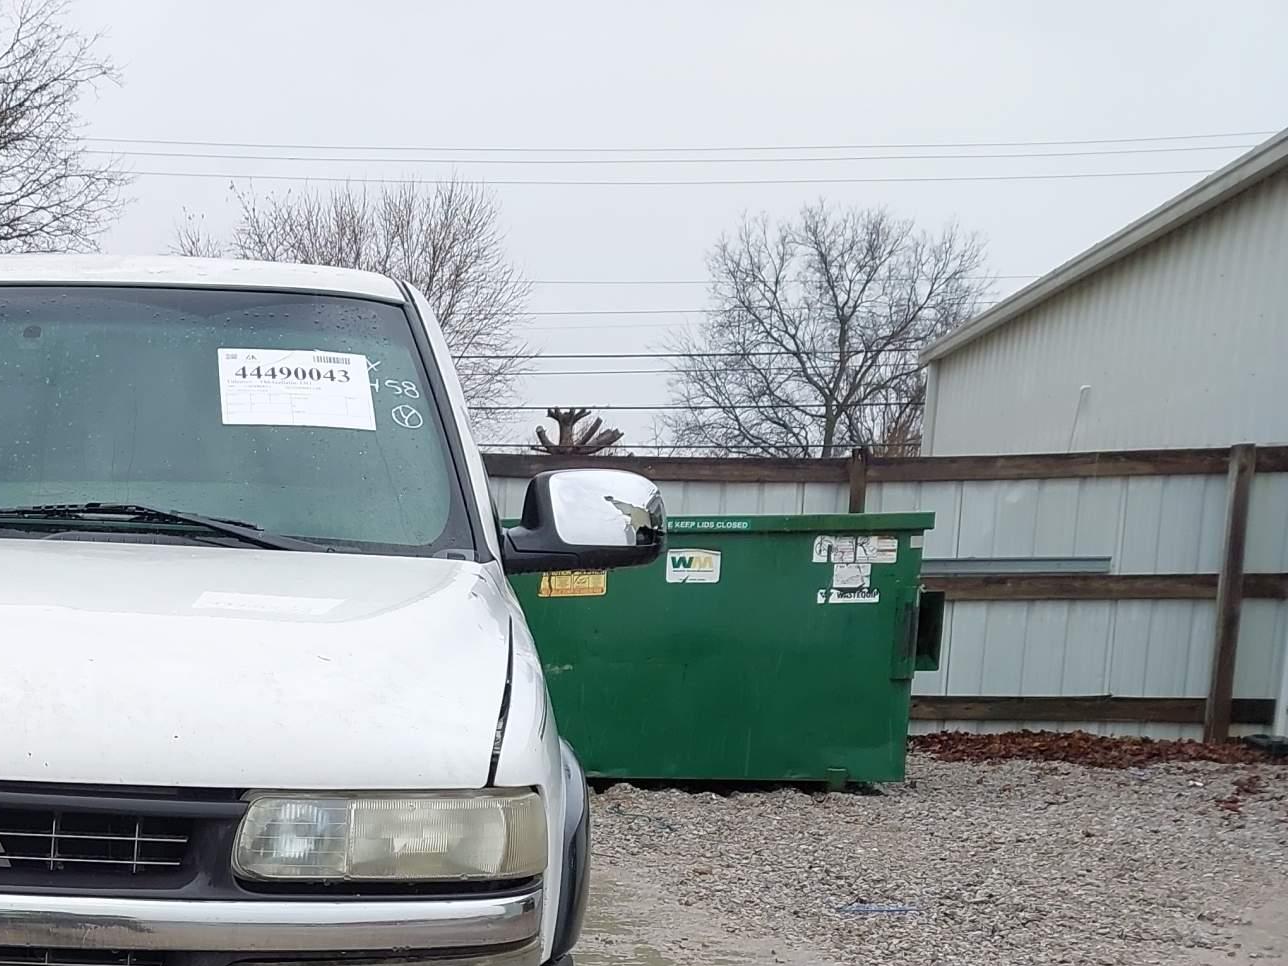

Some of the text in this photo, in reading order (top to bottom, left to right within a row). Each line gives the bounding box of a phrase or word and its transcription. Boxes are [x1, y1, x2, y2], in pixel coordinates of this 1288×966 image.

[234, 365, 351, 383] 44490043
[674, 521, 696, 529] KEEP
[697, 521, 715, 529] LIDS
[716, 521, 749, 529] CLOSED
[671, 555, 714, 569] WM
